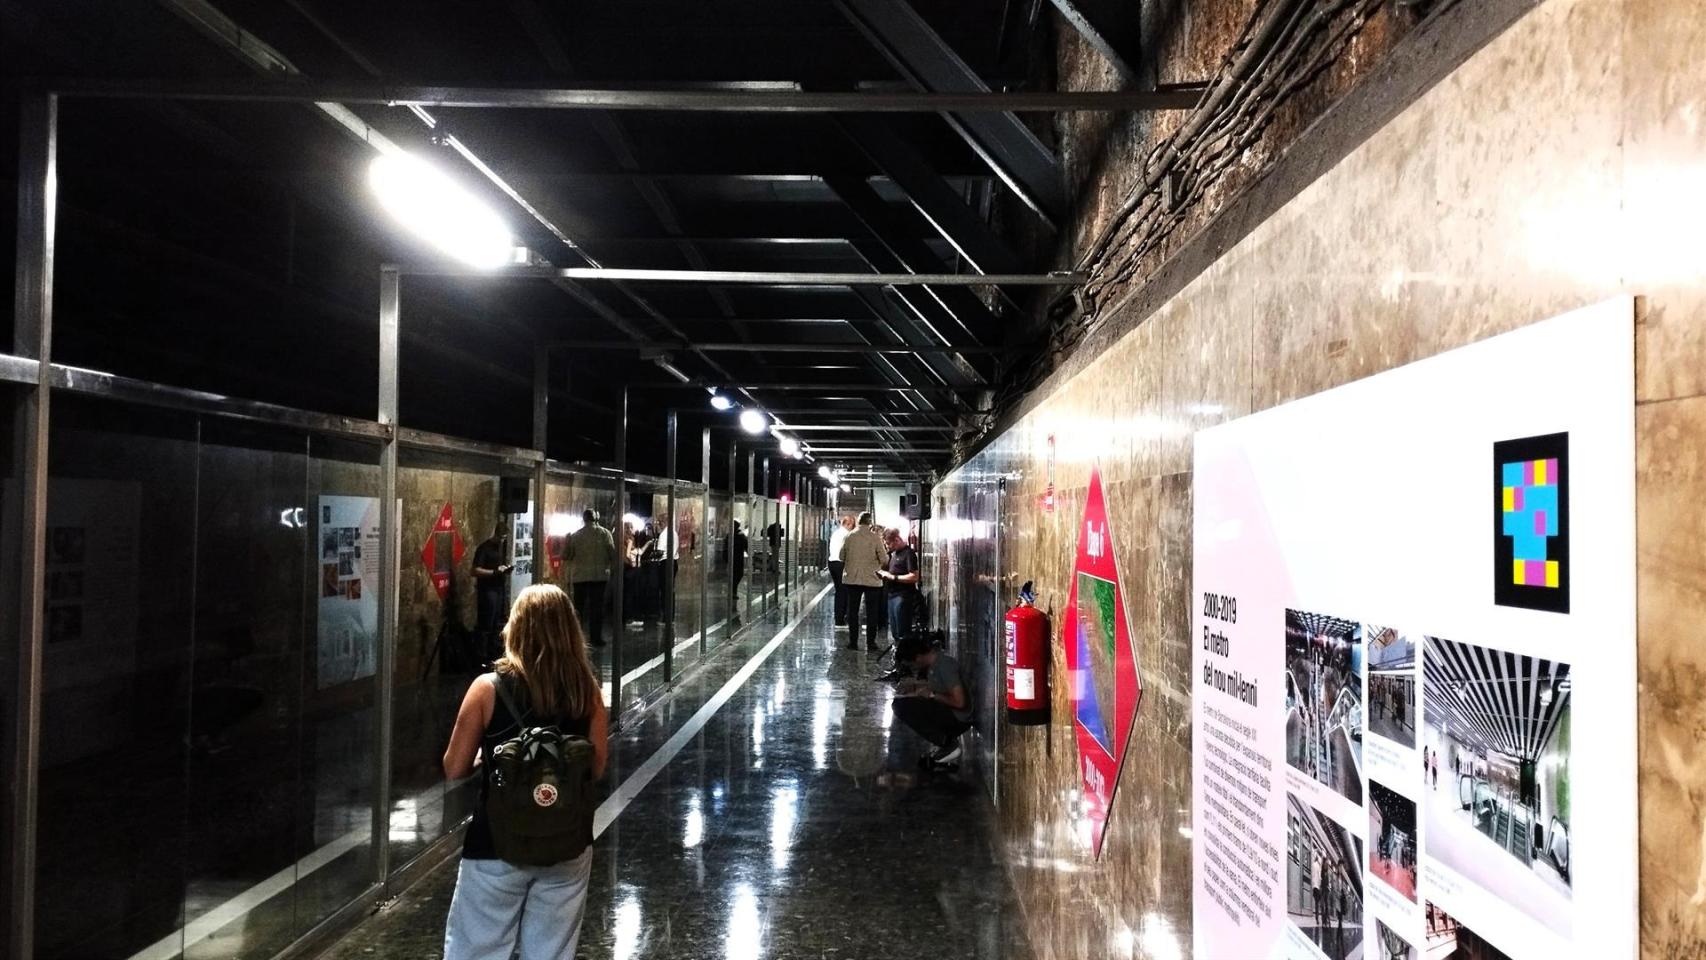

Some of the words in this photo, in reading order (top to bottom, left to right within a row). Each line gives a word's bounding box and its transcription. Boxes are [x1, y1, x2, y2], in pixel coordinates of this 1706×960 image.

[1204, 591, 1237, 625] 2000-2019
[1203, 625, 1210, 651] El
[1210, 630, 1229, 658] metro
[1203, 659, 1213, 687] del
[1213, 668, 1226, 693] nou
